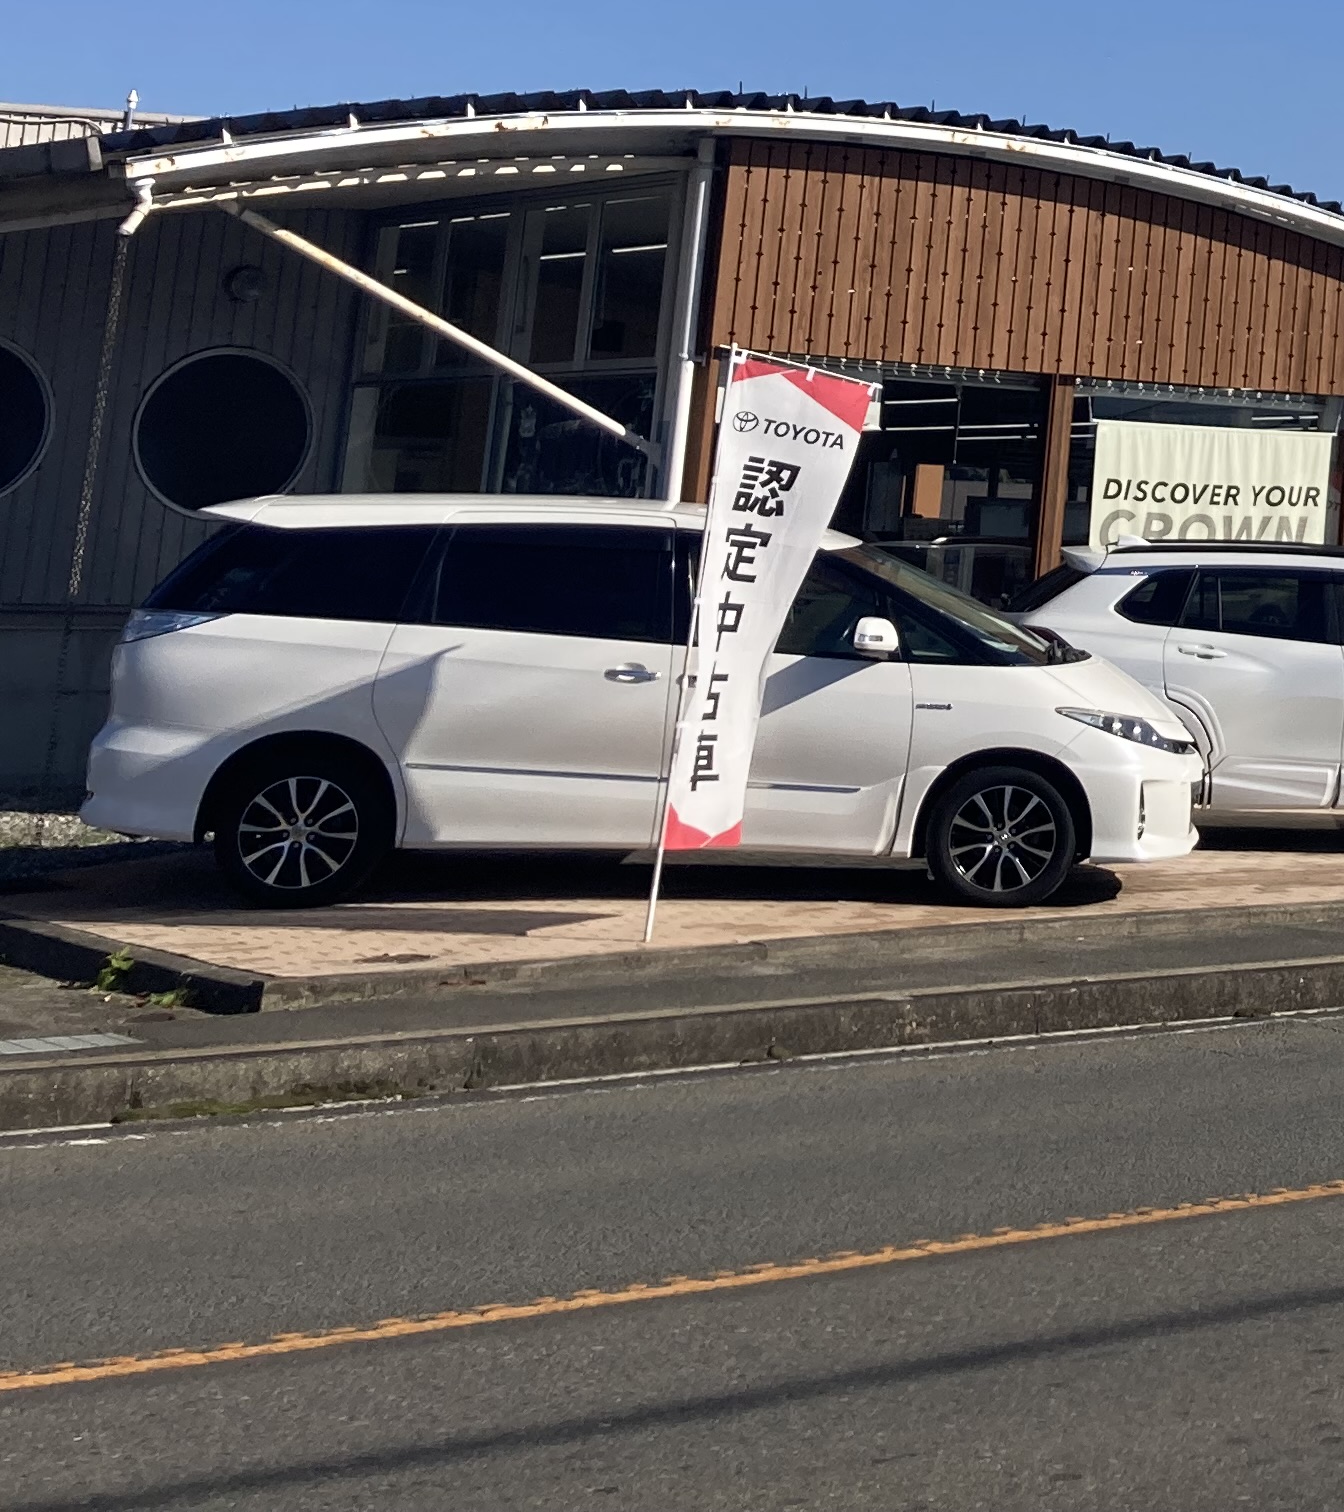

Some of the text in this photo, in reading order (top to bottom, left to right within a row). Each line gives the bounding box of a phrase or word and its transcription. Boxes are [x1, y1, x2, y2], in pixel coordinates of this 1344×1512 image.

[763, 418, 845, 450] TOYOTA
[1102, 478, 1240, 506] DISCOVER
[1251, 485, 1320, 508] YOUR
